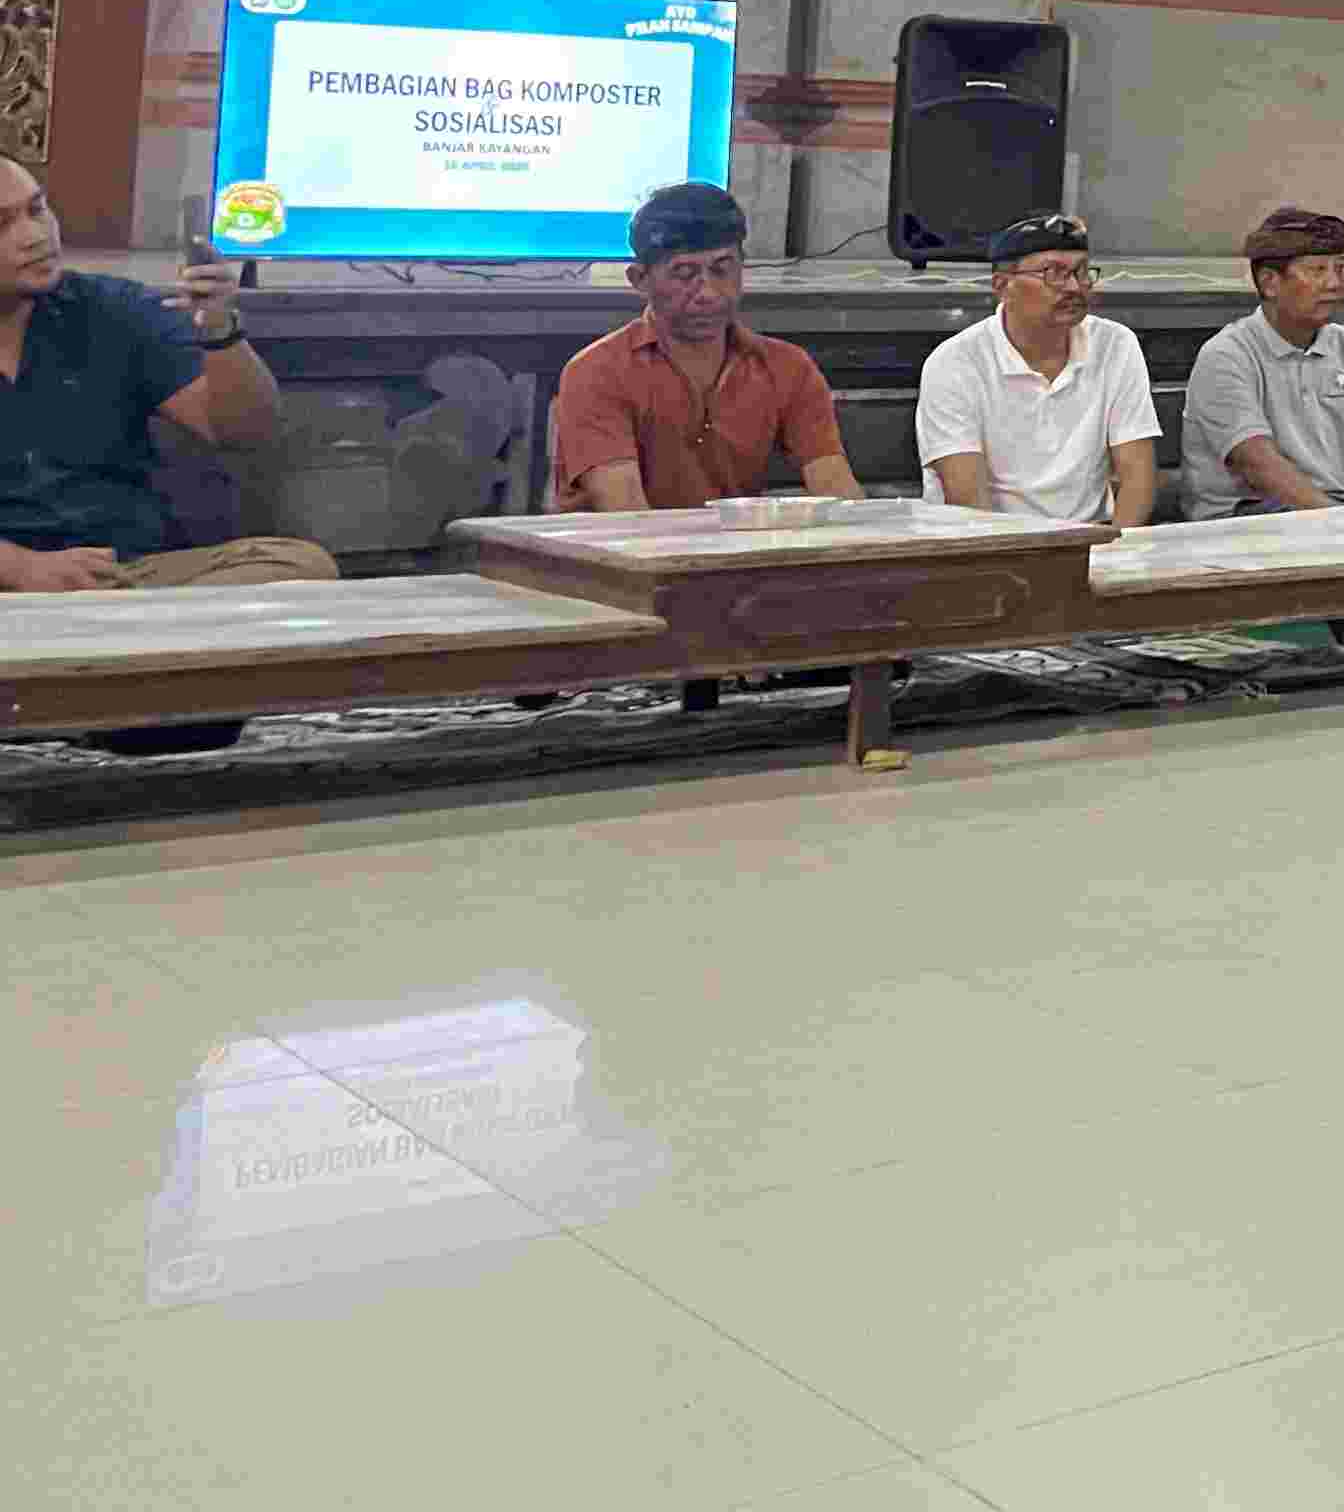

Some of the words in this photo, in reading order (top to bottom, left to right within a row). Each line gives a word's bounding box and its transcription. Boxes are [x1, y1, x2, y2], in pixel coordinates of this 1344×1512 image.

[308, 70, 457, 98] PEMBAGIAN
[465, 76, 513, 100] BAG
[521, 79, 662, 106] KOMPOSTER
[414, 109, 562, 136] SOSIALISASI
[422, 141, 474, 153] BANJAR
[479, 143, 552, 155] KAYANGAN
